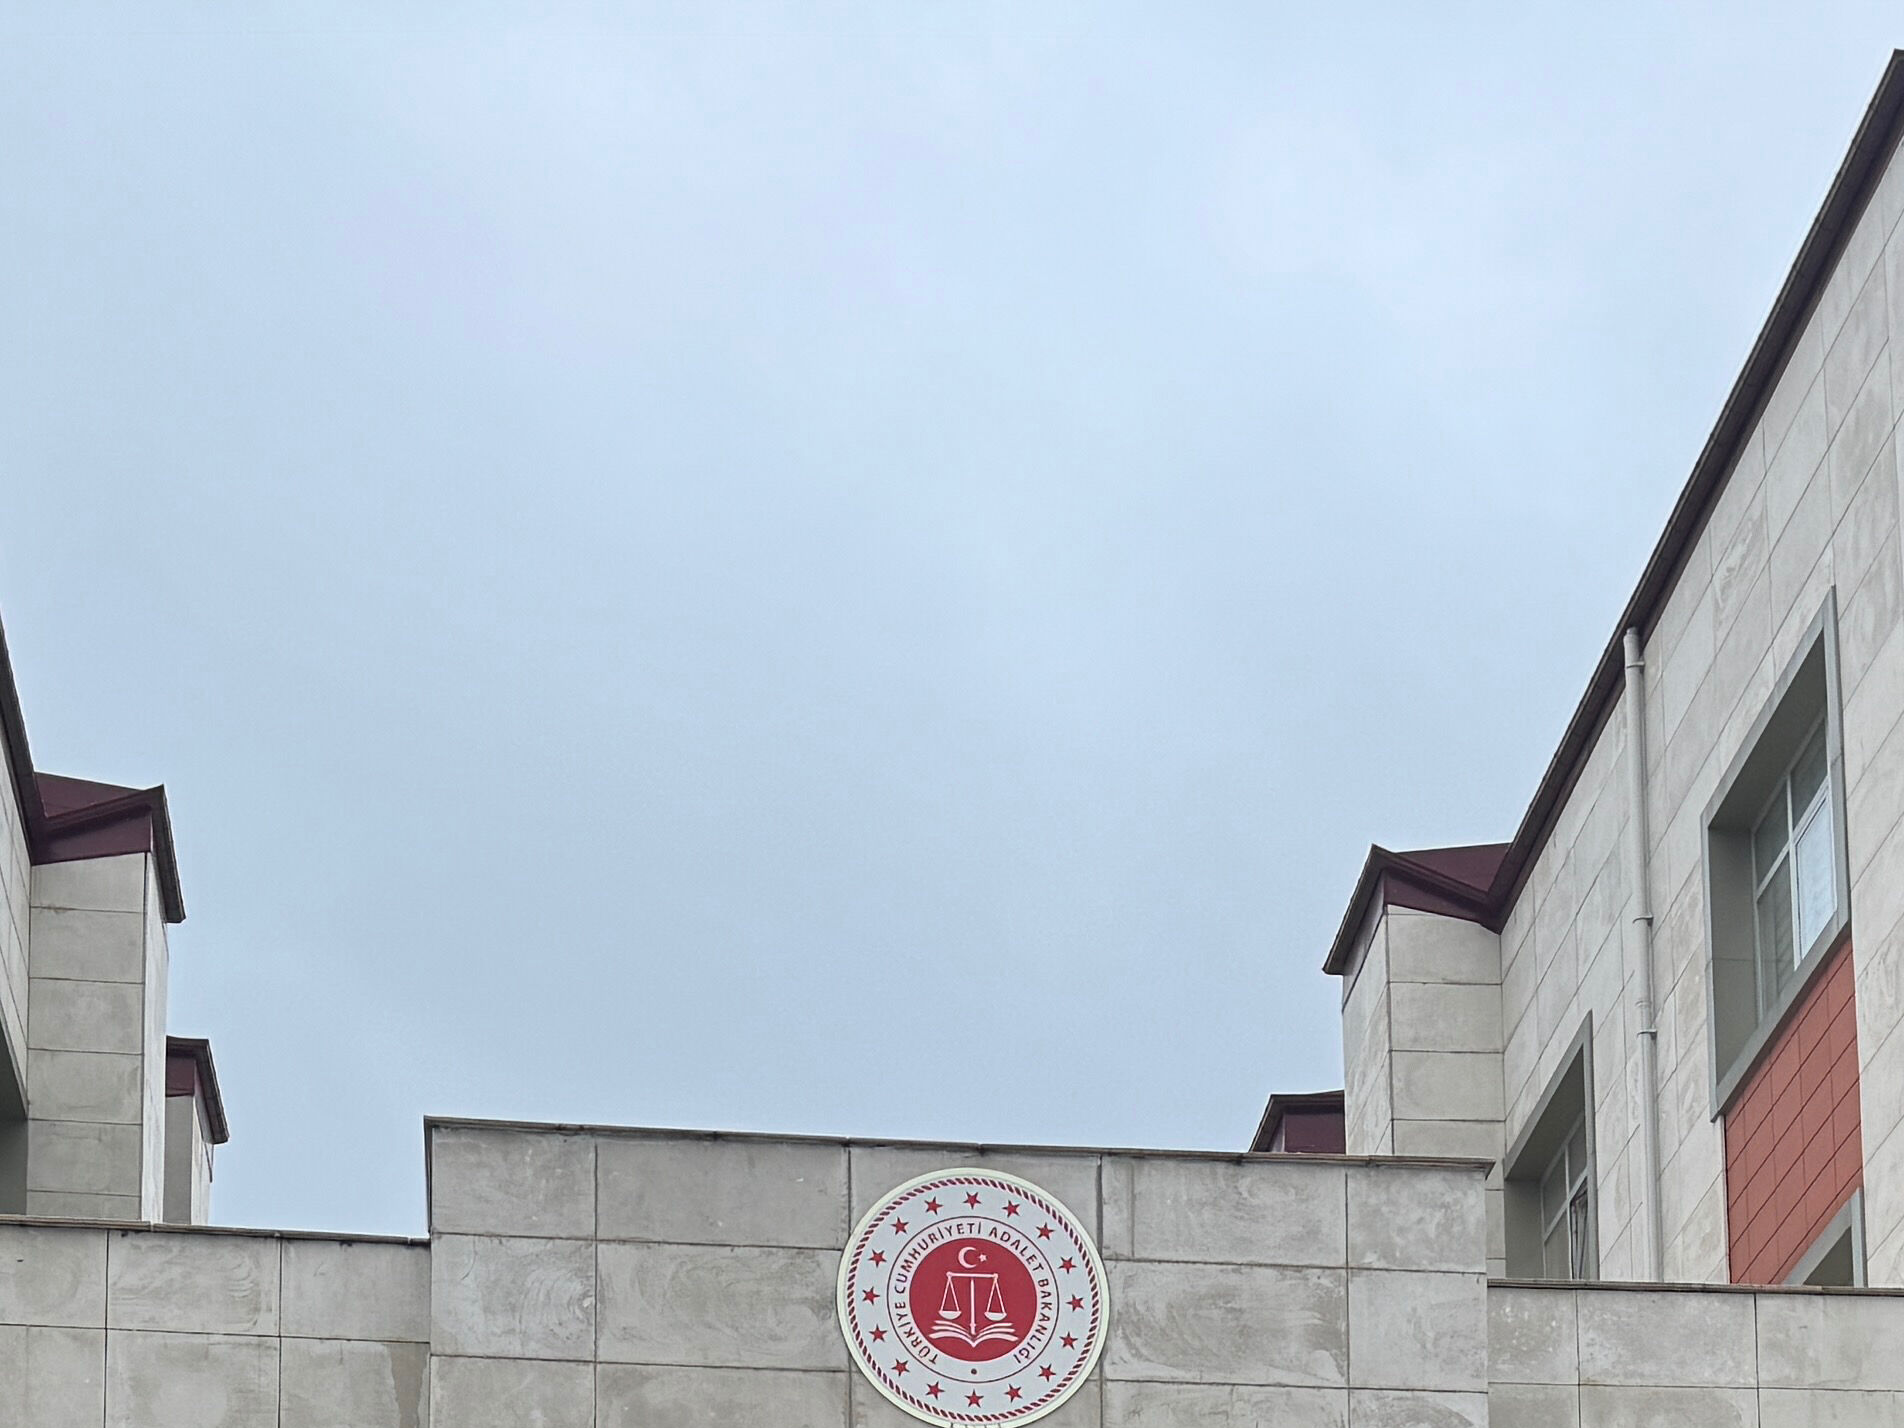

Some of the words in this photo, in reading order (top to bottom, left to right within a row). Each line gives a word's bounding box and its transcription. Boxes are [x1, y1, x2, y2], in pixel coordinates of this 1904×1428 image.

[895, 1222, 983, 1293] CUMHURİYETİ
[988, 1225, 1042, 1272] ADALET
[895, 1302, 937, 1365] TÜRKİYE
[1014, 1278, 1052, 1363] BAKANLIĞI
